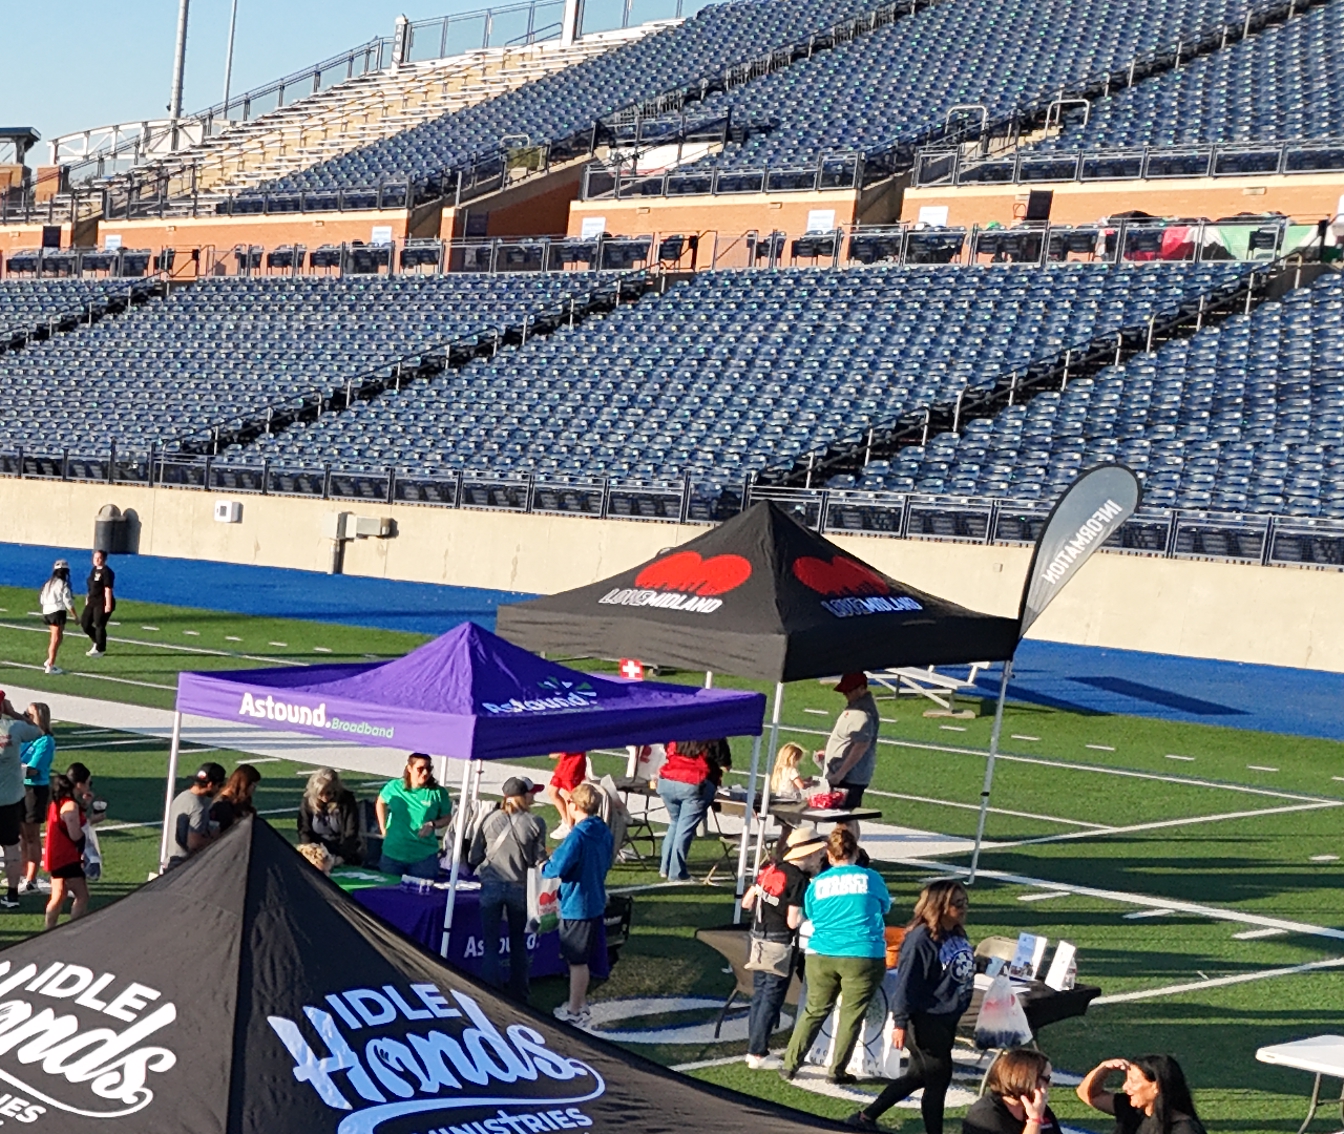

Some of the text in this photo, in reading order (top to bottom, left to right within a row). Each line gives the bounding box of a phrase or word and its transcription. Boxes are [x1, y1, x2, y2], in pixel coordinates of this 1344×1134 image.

[332, 716, 395, 740] Broadband
[24, 961, 162, 1023] IDLE
[324, 982, 462, 1031] IDLE
[266, 987, 589, 1111] Hands
